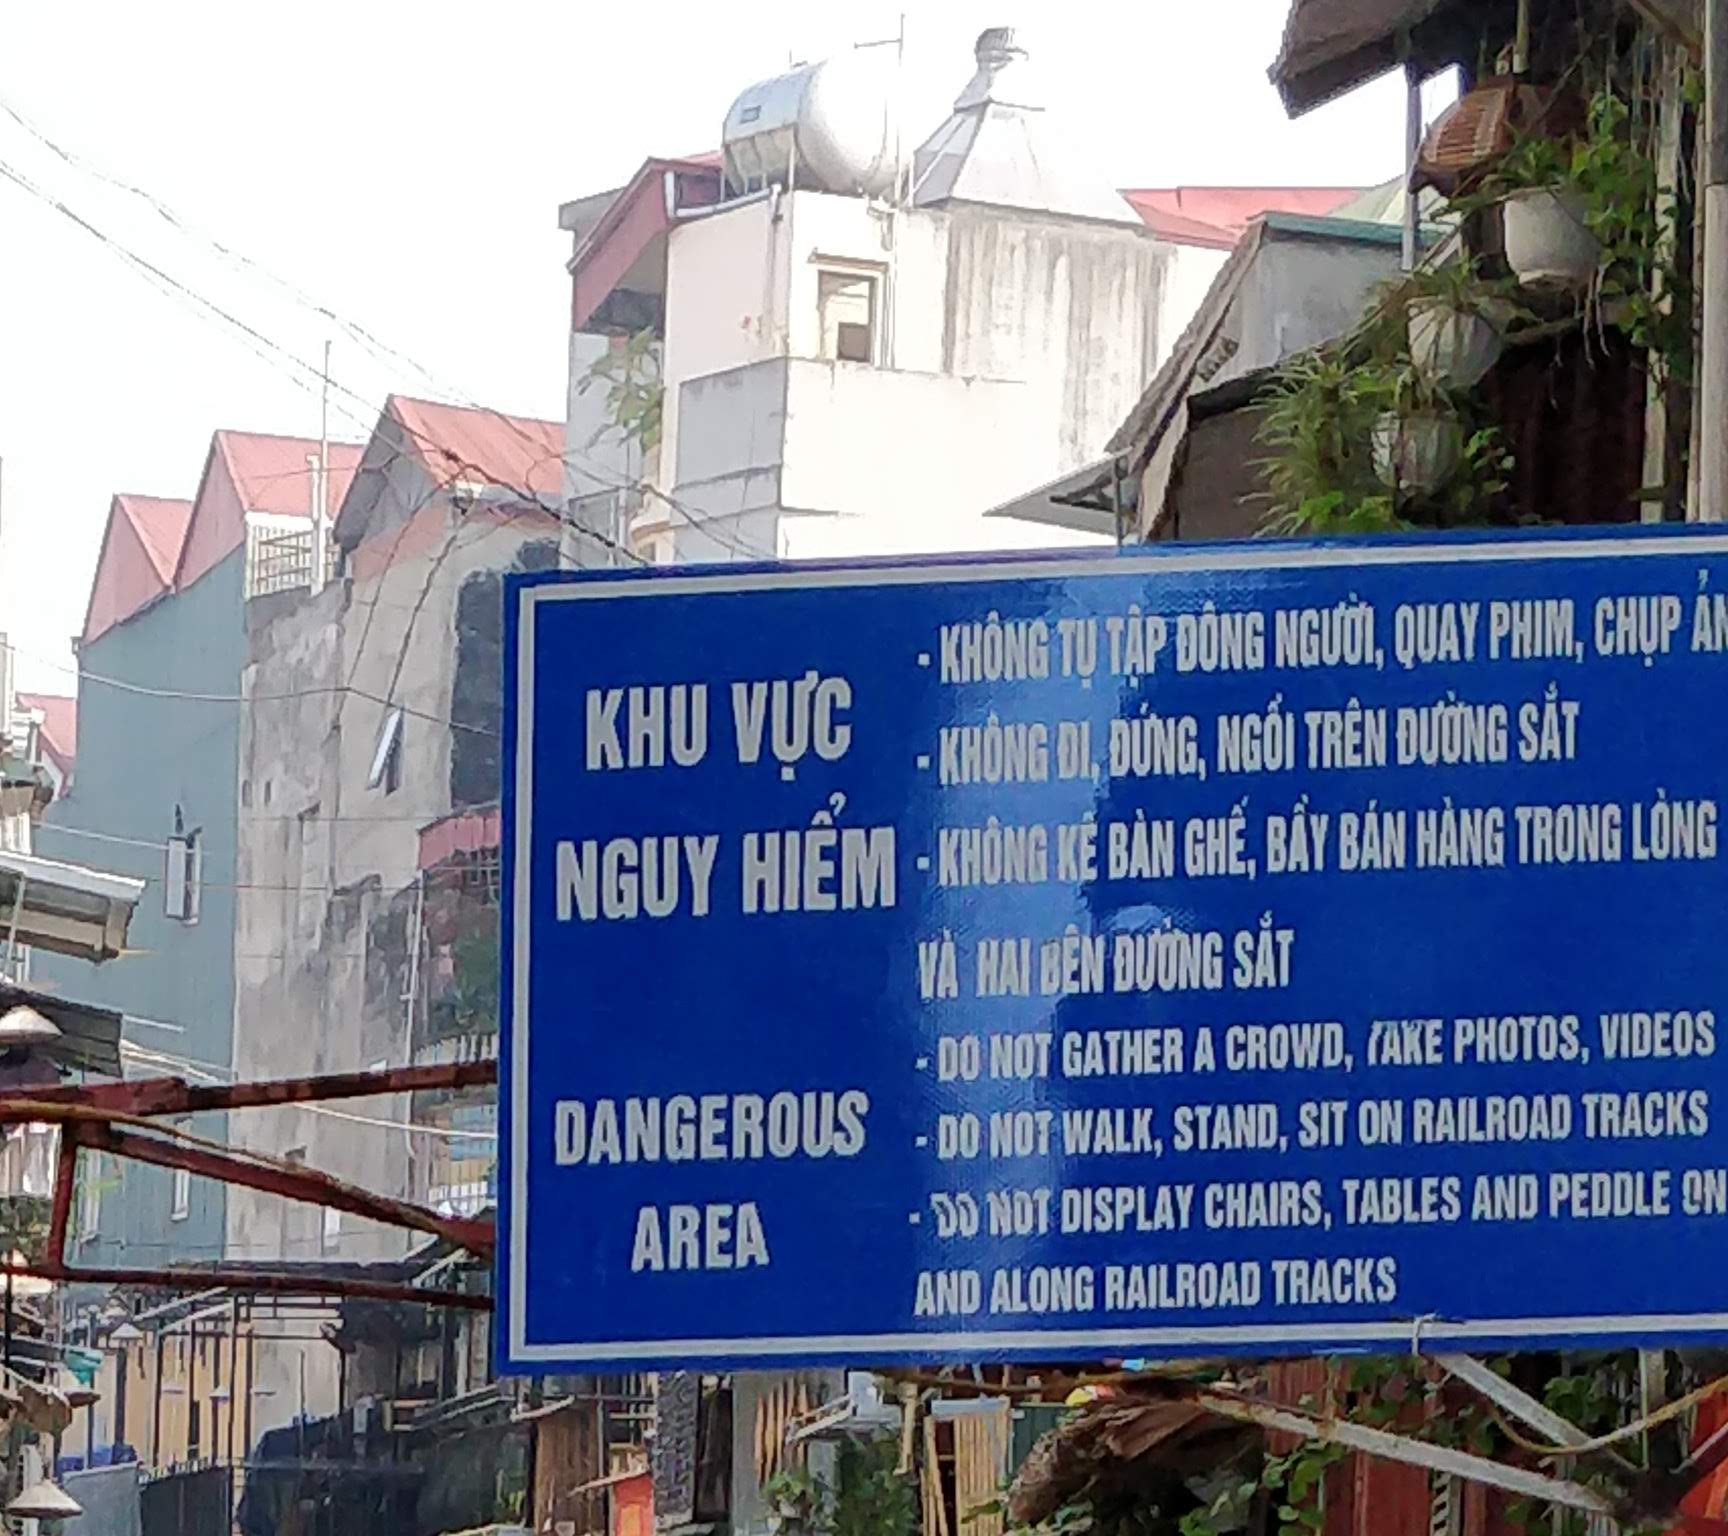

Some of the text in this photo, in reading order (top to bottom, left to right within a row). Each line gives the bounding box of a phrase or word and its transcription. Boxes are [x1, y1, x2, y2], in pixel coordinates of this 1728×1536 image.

[939, 610, 1049, 684] KHÔNG
[1058, 617, 1098, 689] TỤ
[1105, 603, 1168, 689] TẬP
[1175, 600, 1265, 672] ĐÔNG
[1274, 592, 1385, 671] NGƯỜI,
[1394, 600, 1480, 670] QUAY
[1489, 598, 1585, 664] PHIM,
[1594, 594, 1682, 668] CHỤP
[585, 669, 853, 783] KHU VỰC
[938, 681, 1581, 787] KHÔNG ĐI, ĐỨNG, NGỒI TRÊN ĐƯỜNG SẮT
[555, 791, 896, 922] NGUY HIỂM
[938, 814, 1048, 888] KHÔNG
[1108, 808, 1175, 880] BÀN
[1184, 794, 1258, 880] GHẾ,
[1338, 799, 1407, 871] BÁN
[1415, 796, 1506, 870] HÀNG
[1514, 803, 1622, 864] TRONG
[1632, 787, 1718, 861] LÒNG
[918, 910, 1296, 999] VÀ HAI BÊN ĐƯỜNG SẮT
[937, 1010, 1716, 1082] DO NOT GATHER A CROWD, TAKE PHOTOS, VIDEOS
[554, 1090, 871, 1167] DANGEROUS
[937, 1089, 1710, 1161] DO NOT WALK, STAND, SIT ON RAILROAD TRACKS
[630, 1201, 770, 1272] AREA
[930, 1168, 1727, 1239] DO NOT DISPLAY CHAIRS, TABLES AND PEDDLE ON
[913, 1256, 1398, 1317] AND ALONG RAILROAD TRACKS
